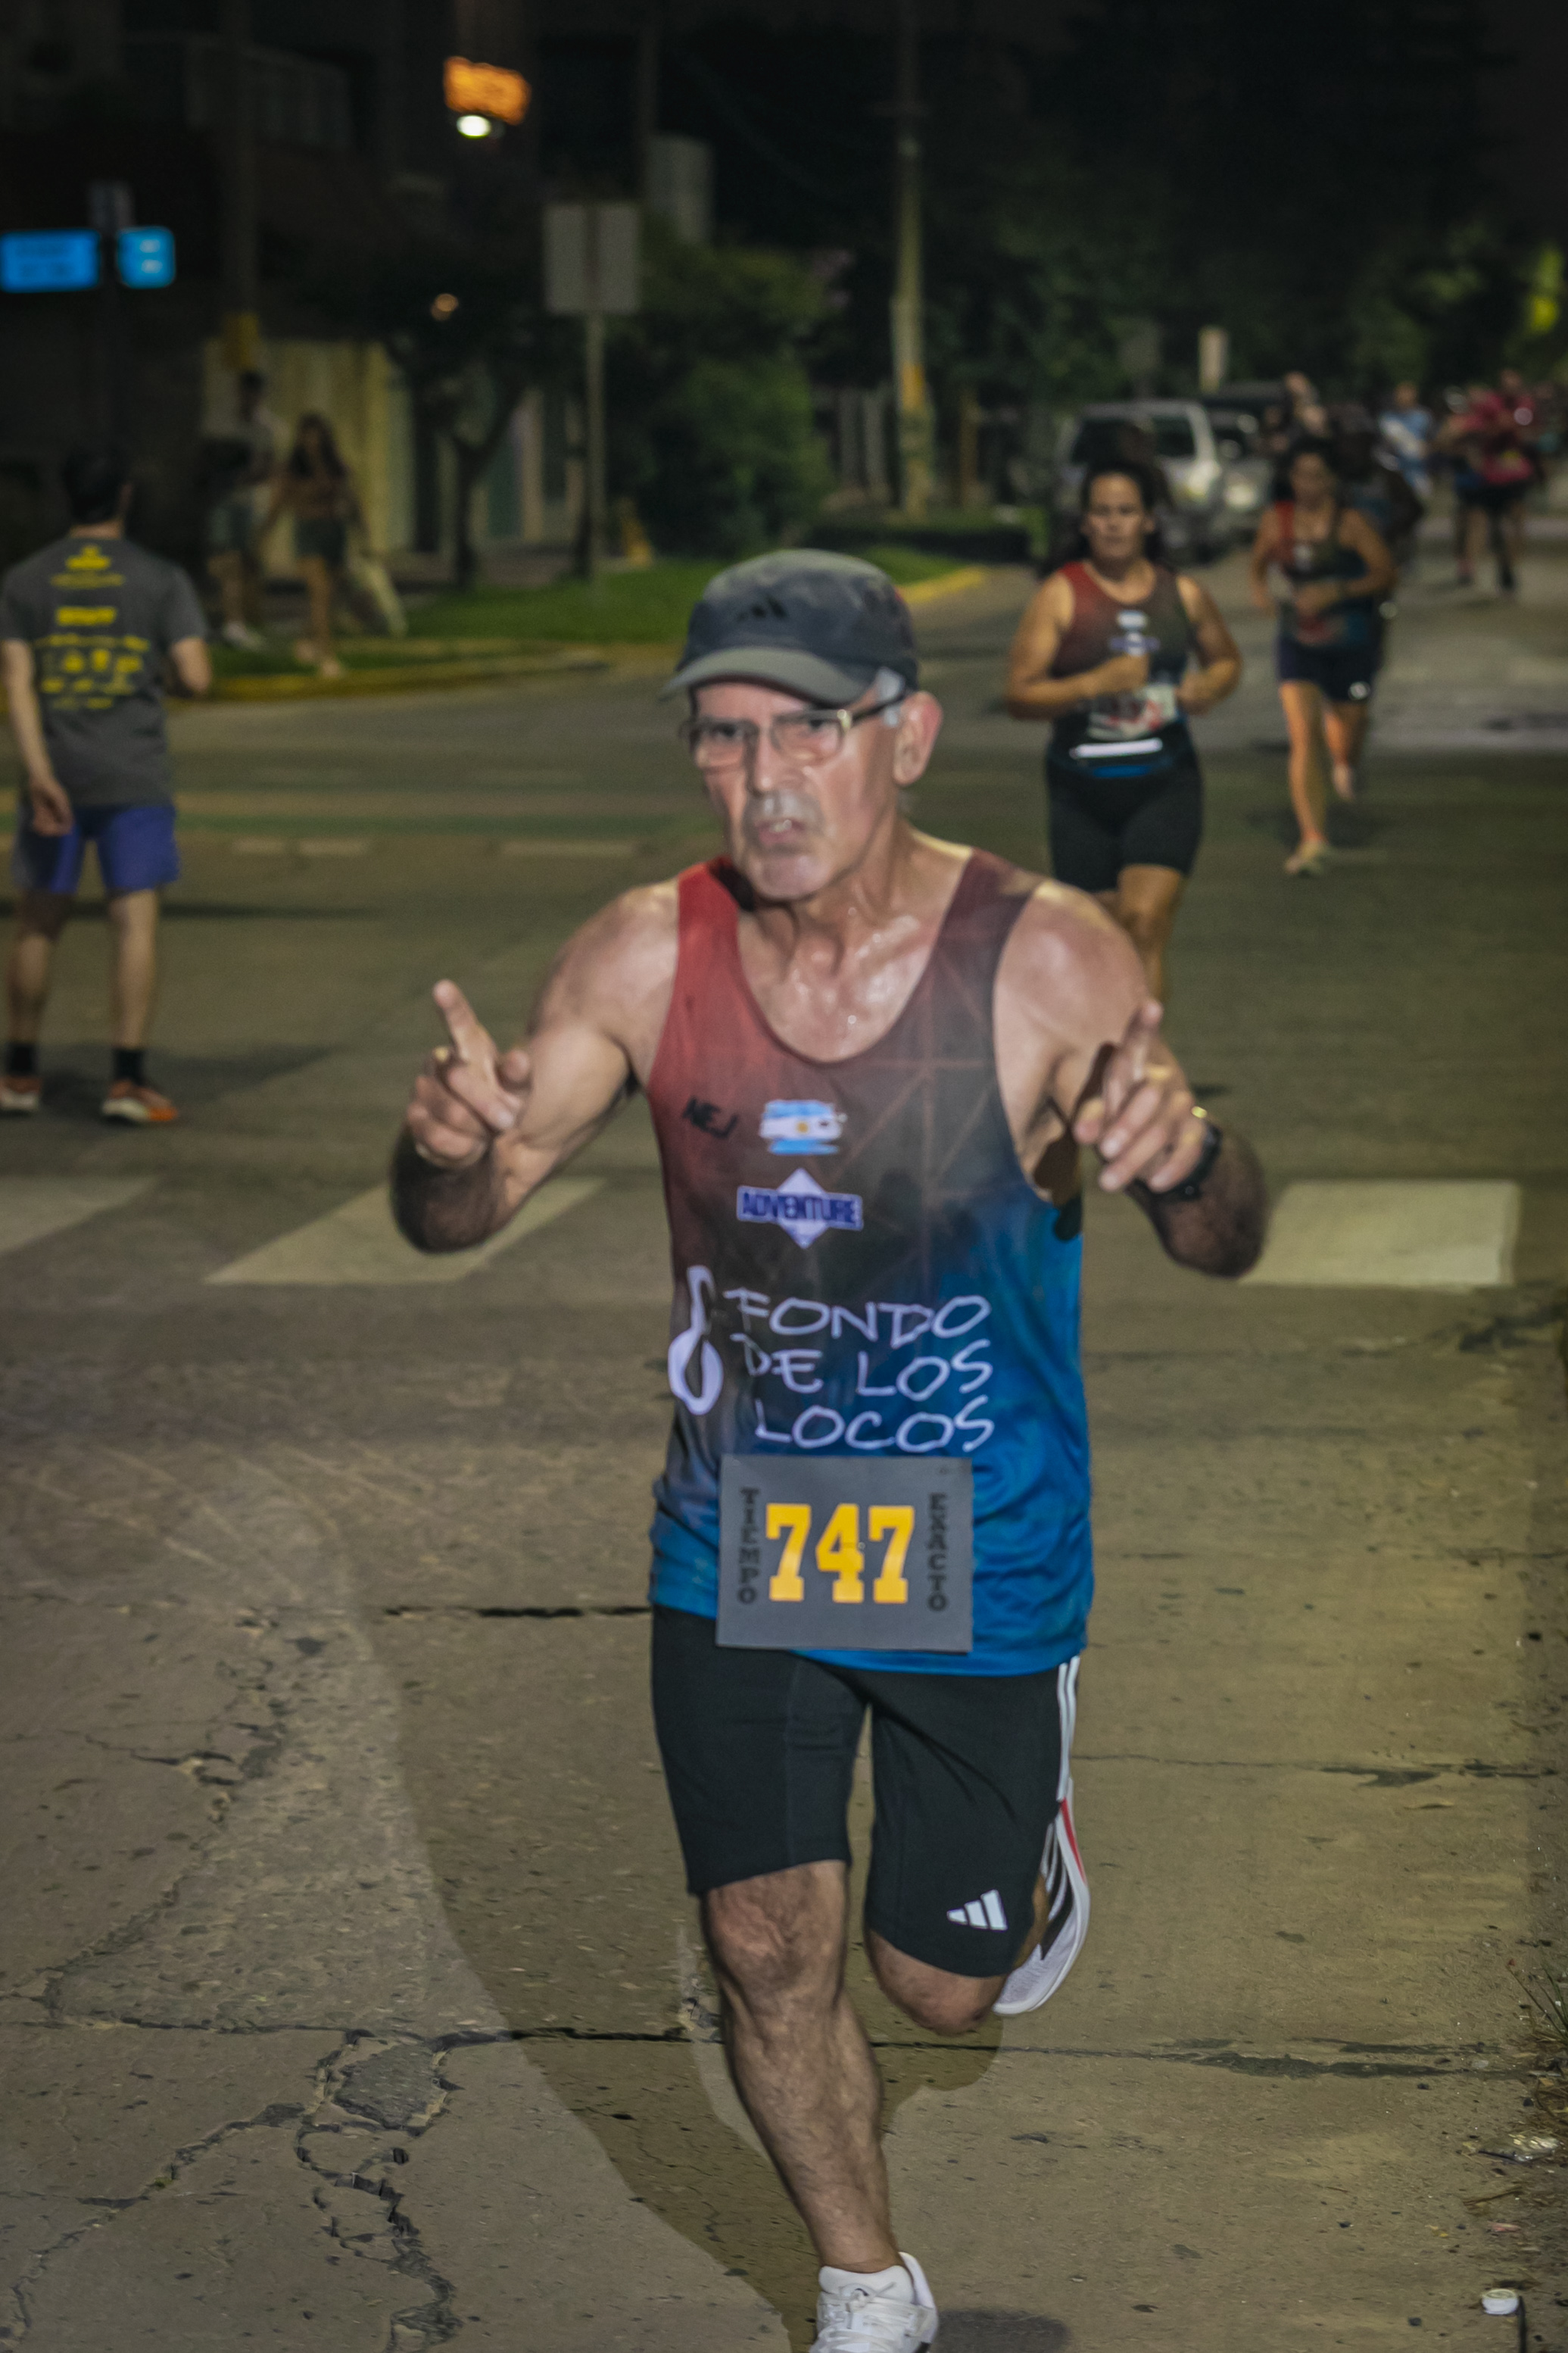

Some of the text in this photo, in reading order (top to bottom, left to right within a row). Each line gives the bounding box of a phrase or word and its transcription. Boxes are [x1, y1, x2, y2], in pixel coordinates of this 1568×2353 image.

[723, 1287, 991, 1349] FONDO
[730, 1332, 993, 1402] DE LOS
[755, 1394, 995, 1453] LOCOS
[737, 1487, 760, 1605] TIEMPO
[765, 1502, 915, 1605] 747
[927, 1491, 949, 1612] EXACTO
